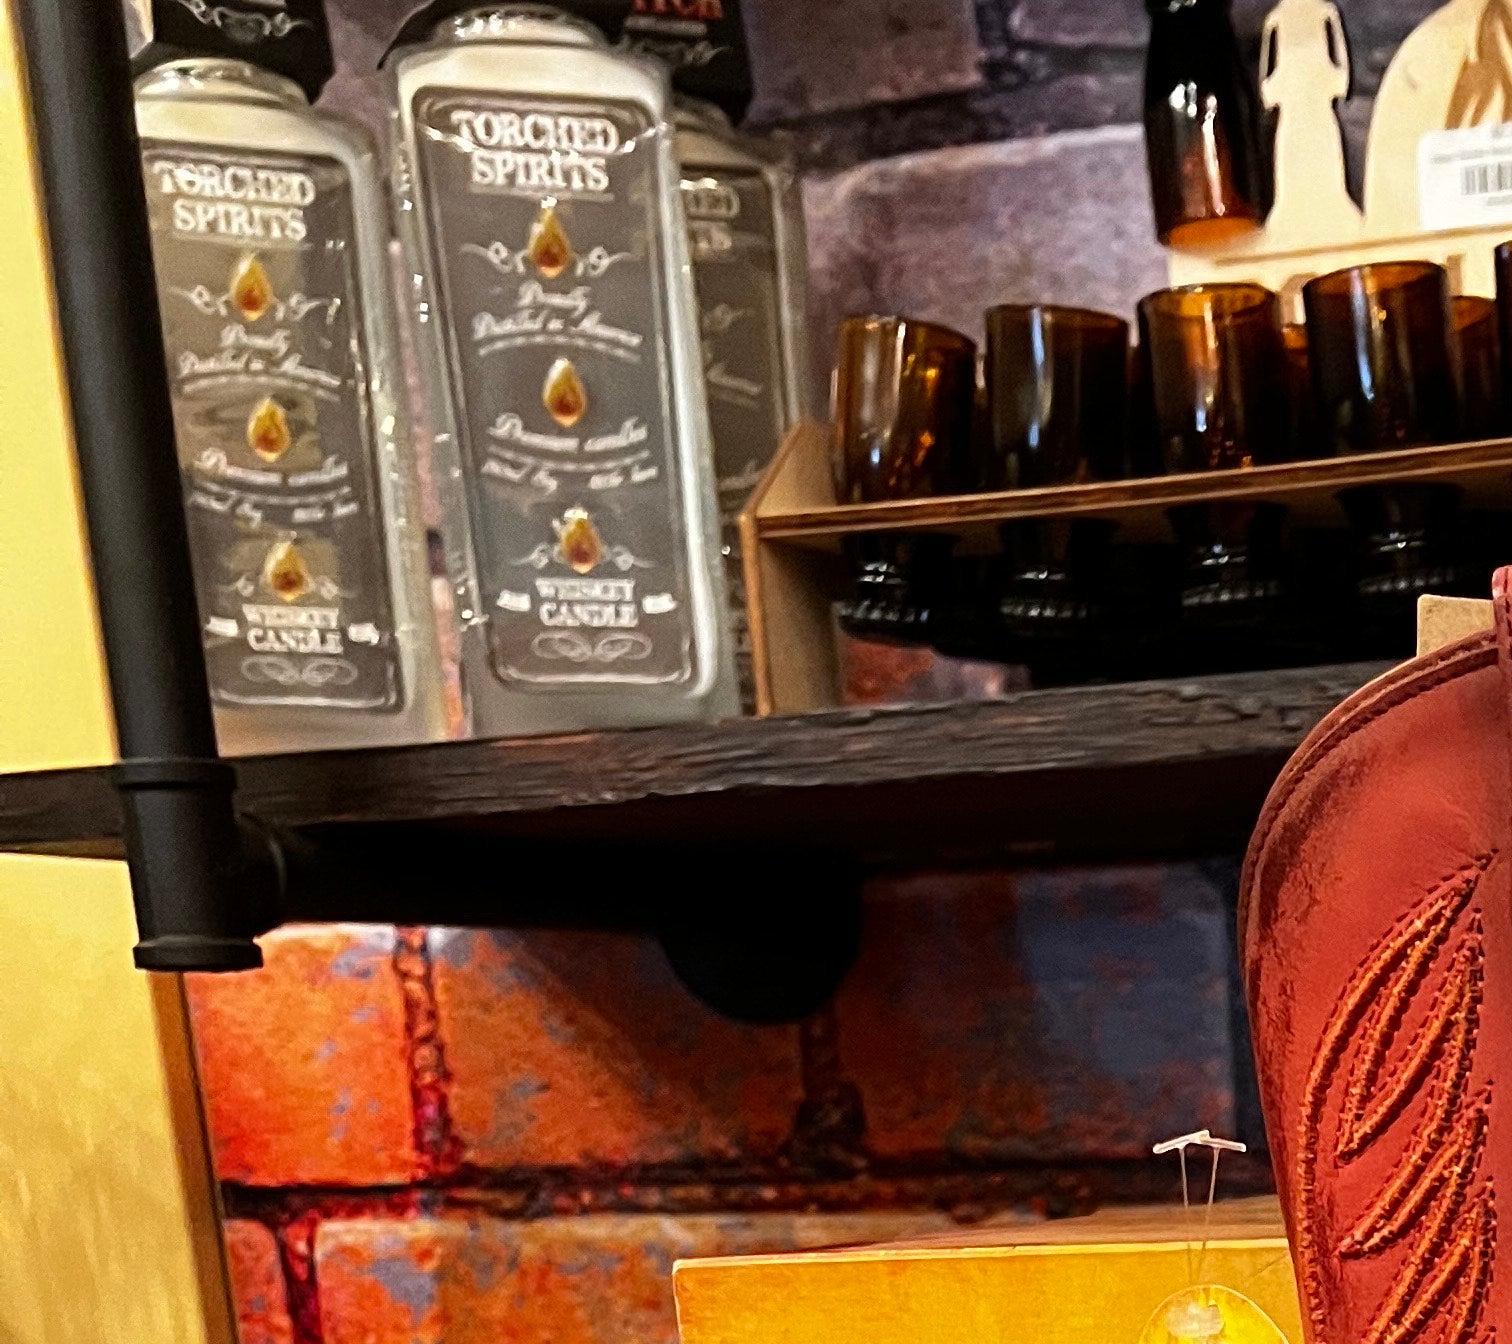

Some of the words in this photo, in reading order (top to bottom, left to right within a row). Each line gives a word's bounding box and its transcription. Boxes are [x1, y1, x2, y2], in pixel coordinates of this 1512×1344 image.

[451, 110, 620, 154] TORCHED
[153, 161, 316, 206] TORCHED
[471, 150, 609, 190] SPIRITS
[173, 199, 307, 241] SPIRITS
